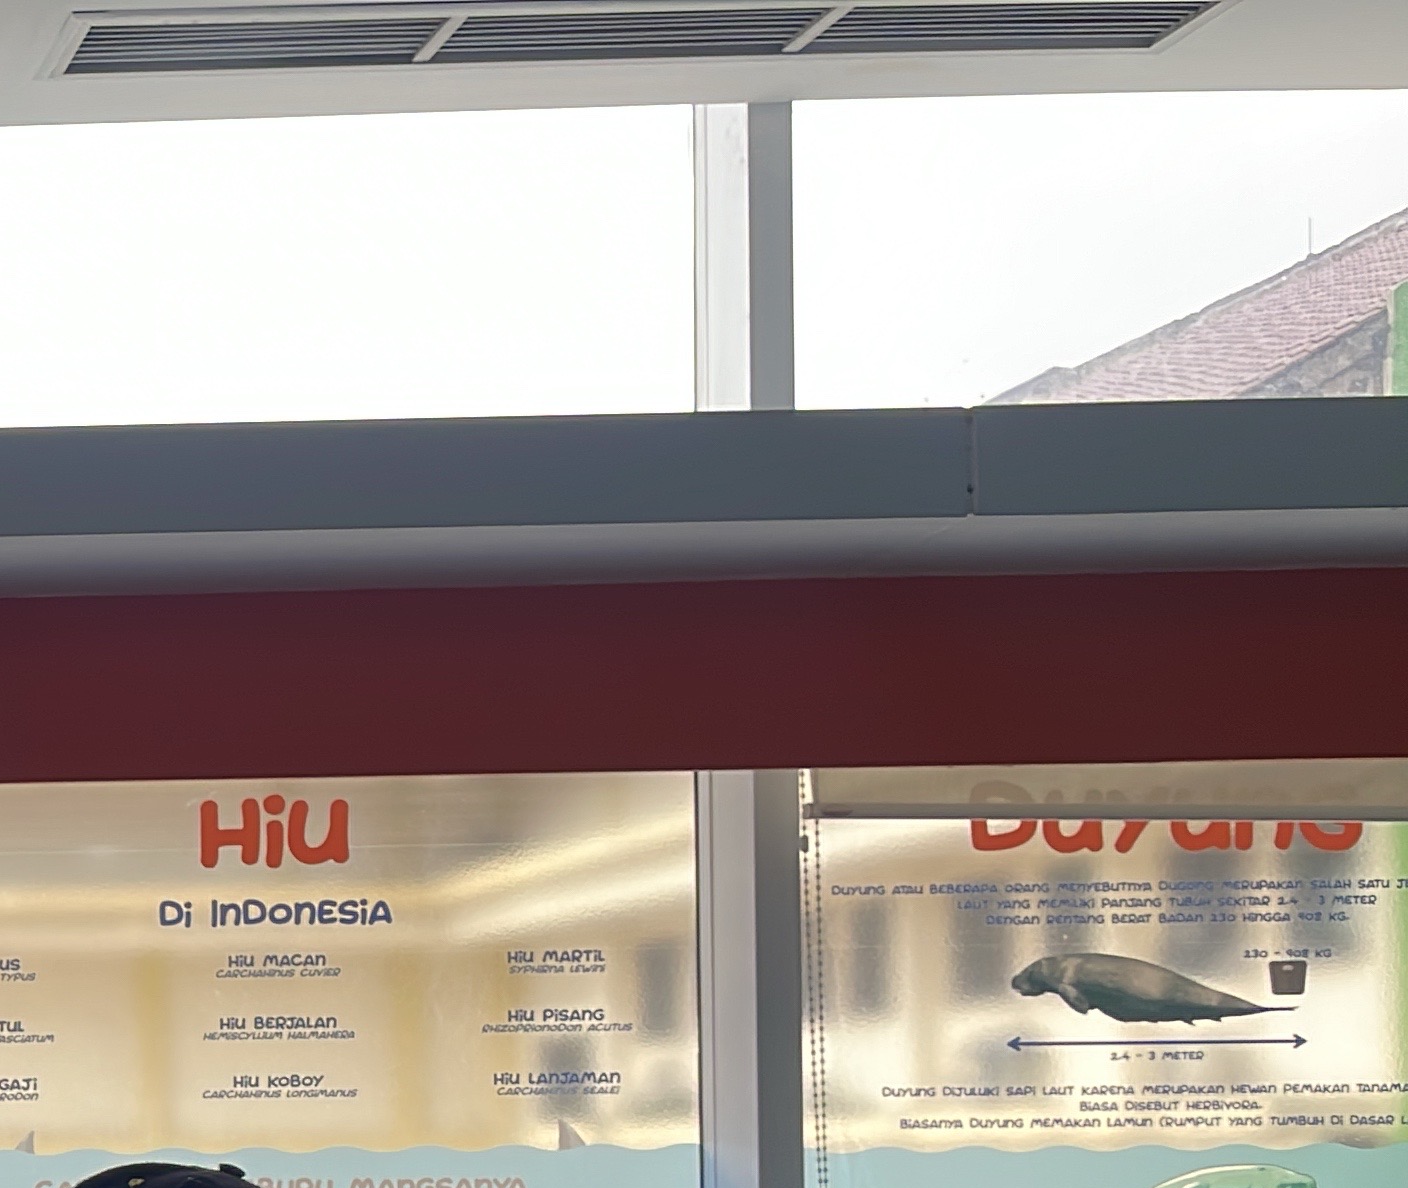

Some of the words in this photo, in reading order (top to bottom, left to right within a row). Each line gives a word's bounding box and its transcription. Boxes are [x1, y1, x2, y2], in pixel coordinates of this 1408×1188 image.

[211, 896, 393, 928] INDONESIA
[228, 954, 254, 968] HIU
[263, 953, 326, 968] MACAN
[507, 950, 534, 964] HIU
[542, 949, 605, 964] MARTIL
[219, 1017, 246, 1030] HIU
[254, 1016, 337, 1030] BERJALAN
[508, 1009, 535, 1023] HIU
[542, 1008, 605, 1023] PISANG
[233, 1075, 259, 1089] HIU
[267, 1074, 324, 1089] KOBOY
[493, 1072, 520, 1086] HIU
[528, 1071, 621, 1086] LANJAMAN
